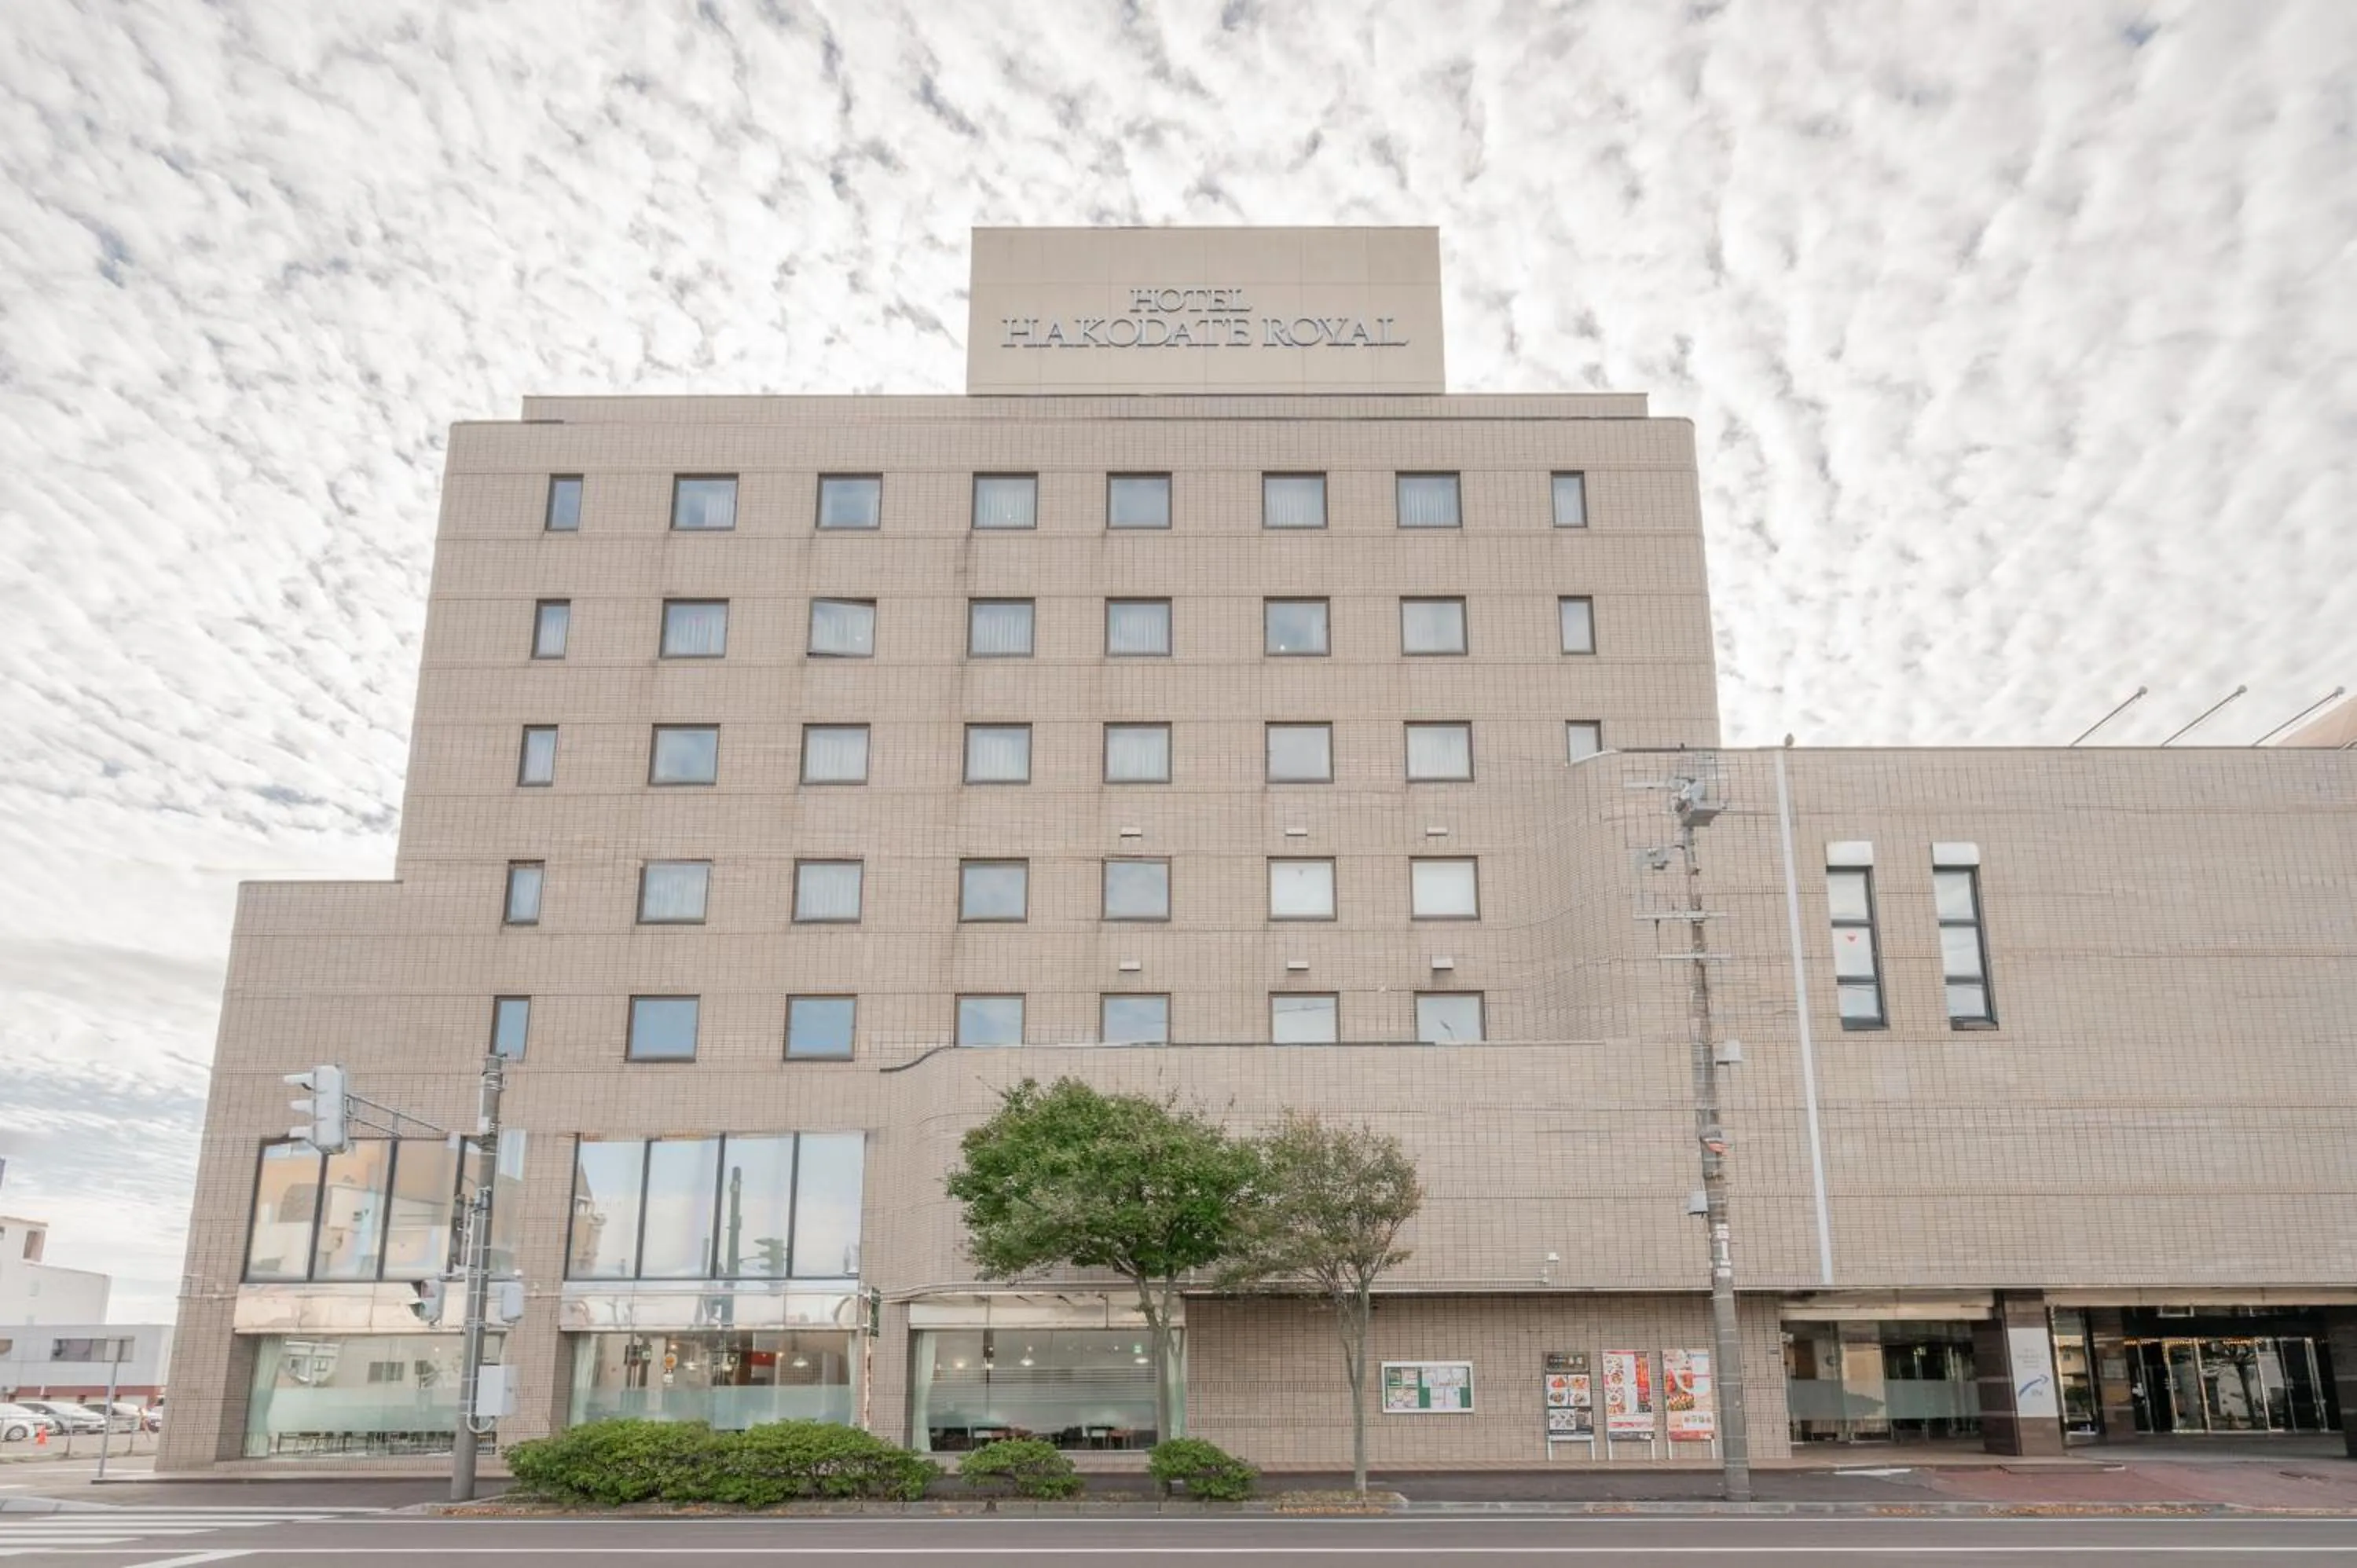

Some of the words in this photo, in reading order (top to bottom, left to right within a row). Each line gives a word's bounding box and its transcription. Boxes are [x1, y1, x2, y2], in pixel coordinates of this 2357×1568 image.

[1129, 288, 1252, 313] HOTEL
[1002, 318, 1253, 347] HAKODATE
[1262, 317, 1409, 346] ROYAL
